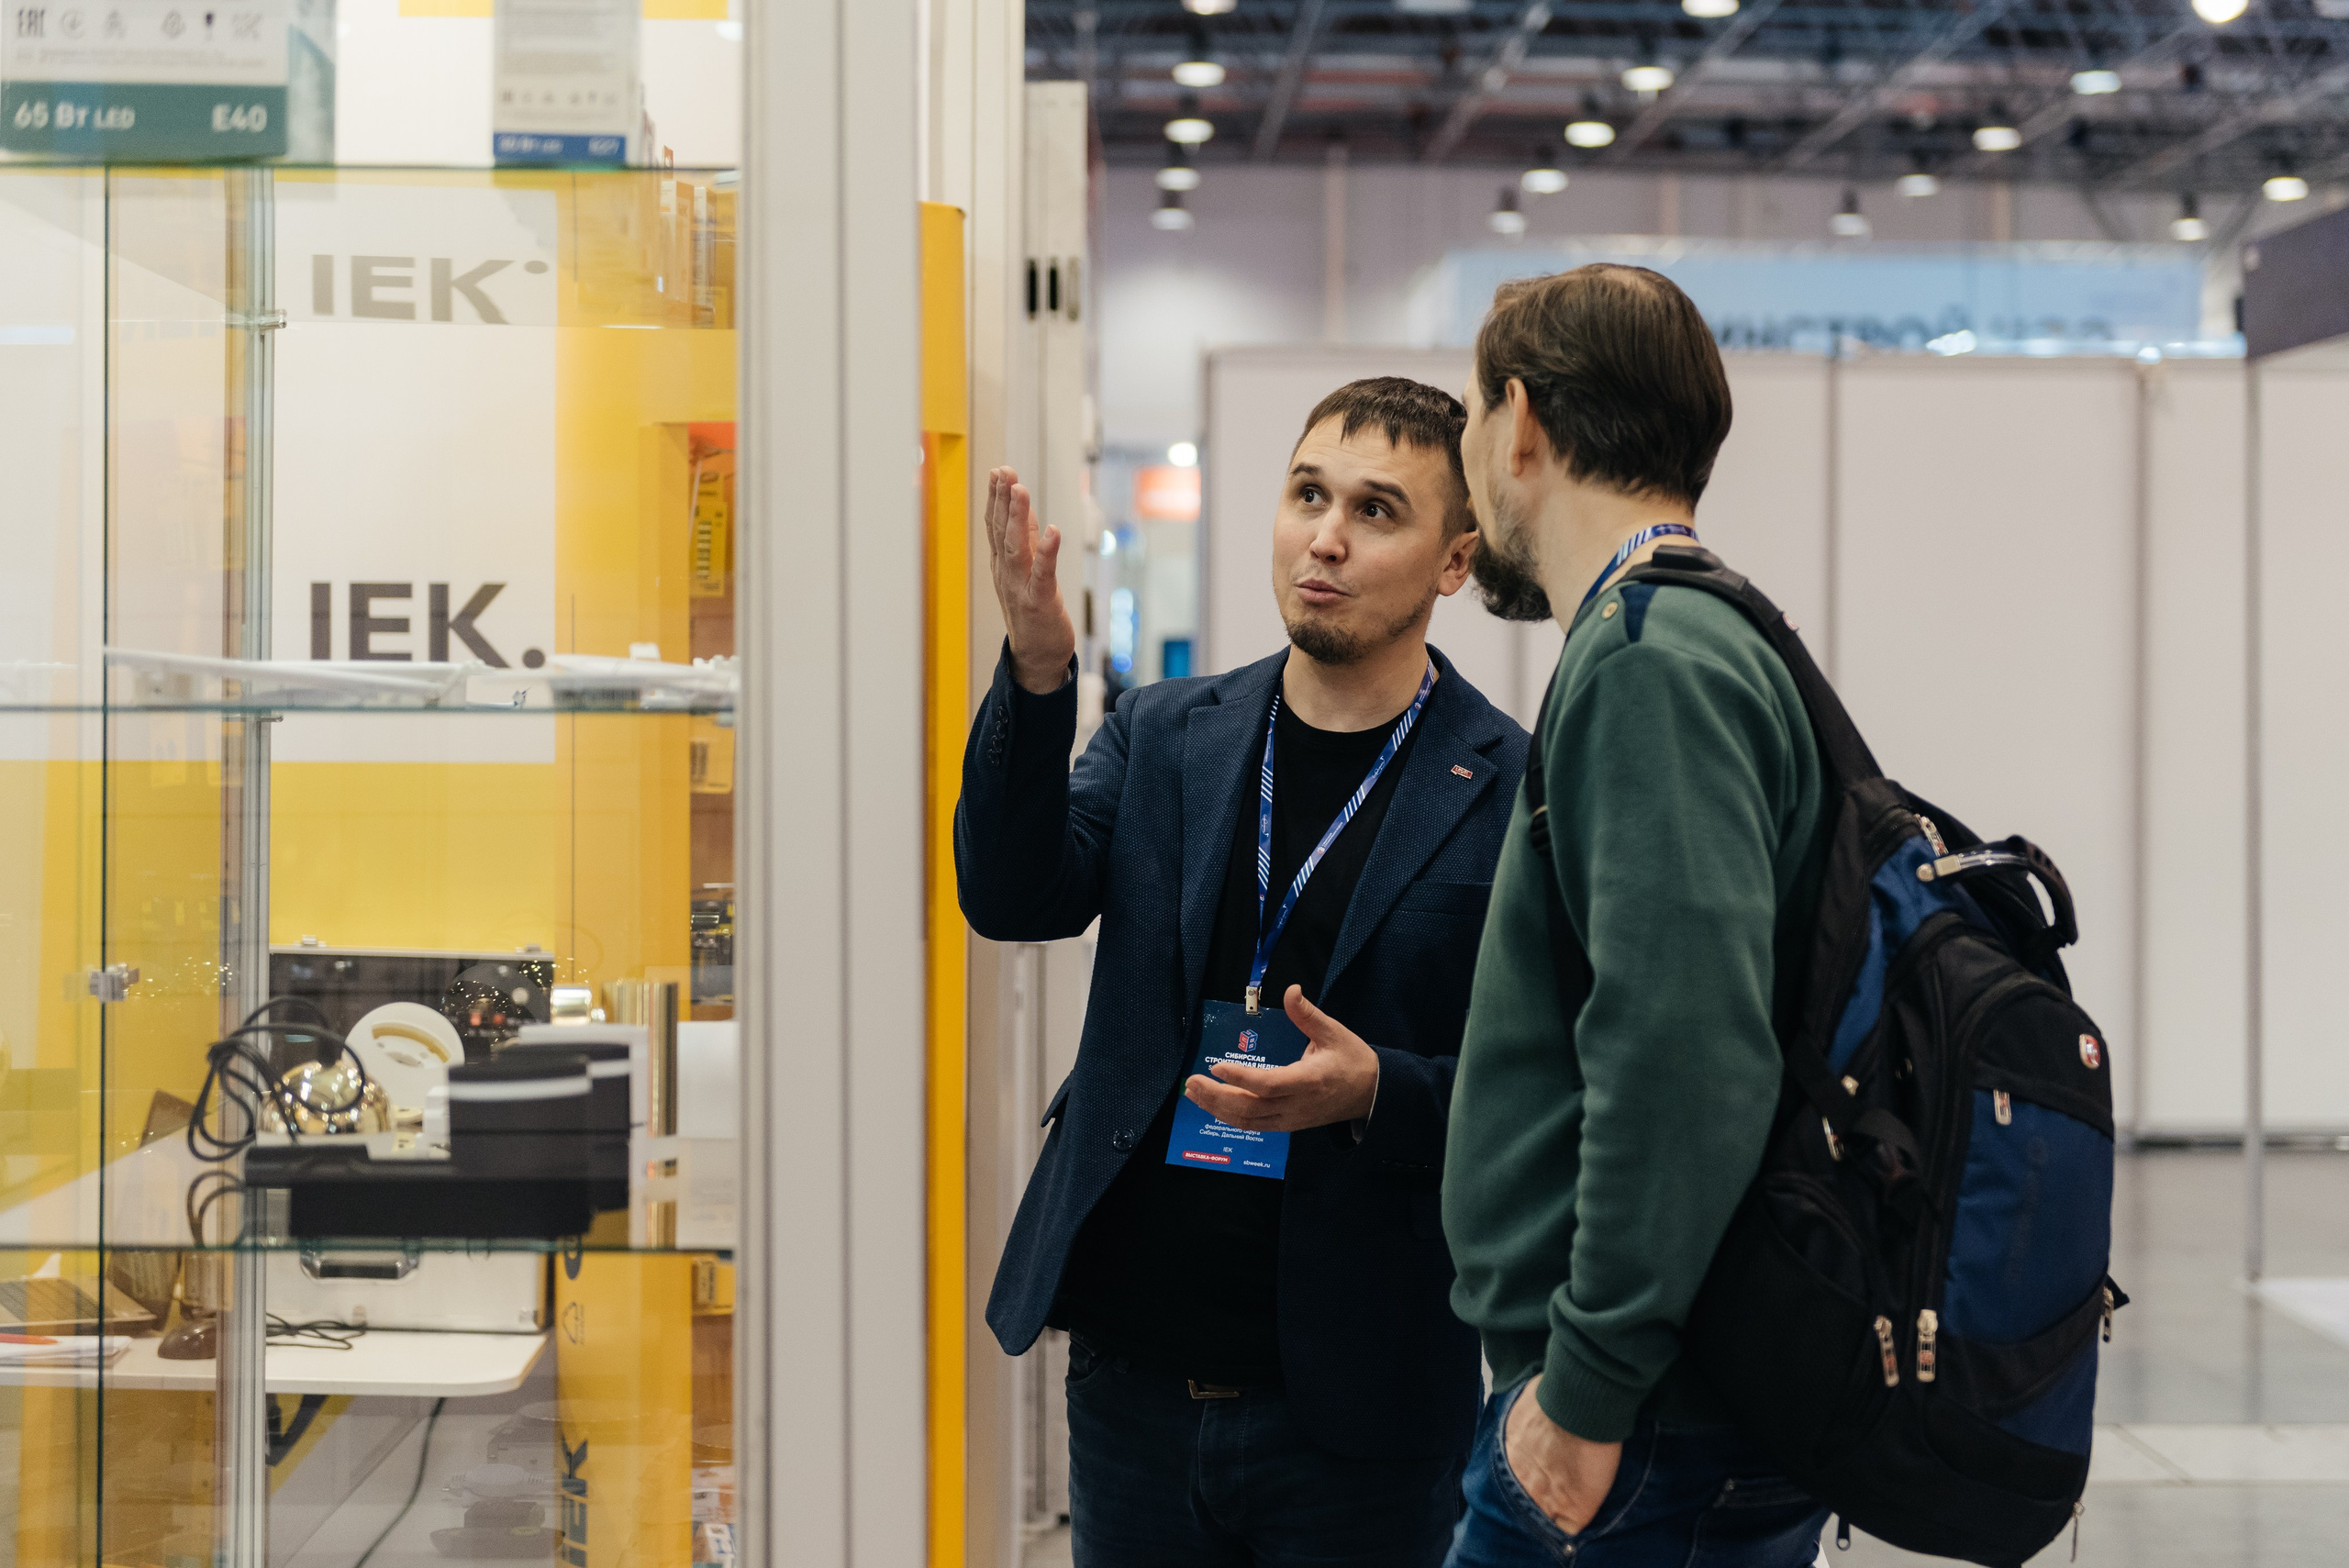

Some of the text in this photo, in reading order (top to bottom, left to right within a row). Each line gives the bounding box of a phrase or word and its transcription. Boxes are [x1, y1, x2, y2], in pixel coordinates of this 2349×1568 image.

[14, 100, 268, 132] 65 Вт LED E40
[1225, 1051, 1265, 1062] СИБИРСКАЯ
[1205, 1124, 1242, 1134] федерального
[1221, 1131, 1244, 1140] Дальний
[1185, 1152, 1229, 1162] ВЫСТАВКА-ФОРУМ
[1243, 1160, 1271, 1168] sbweek.ru
